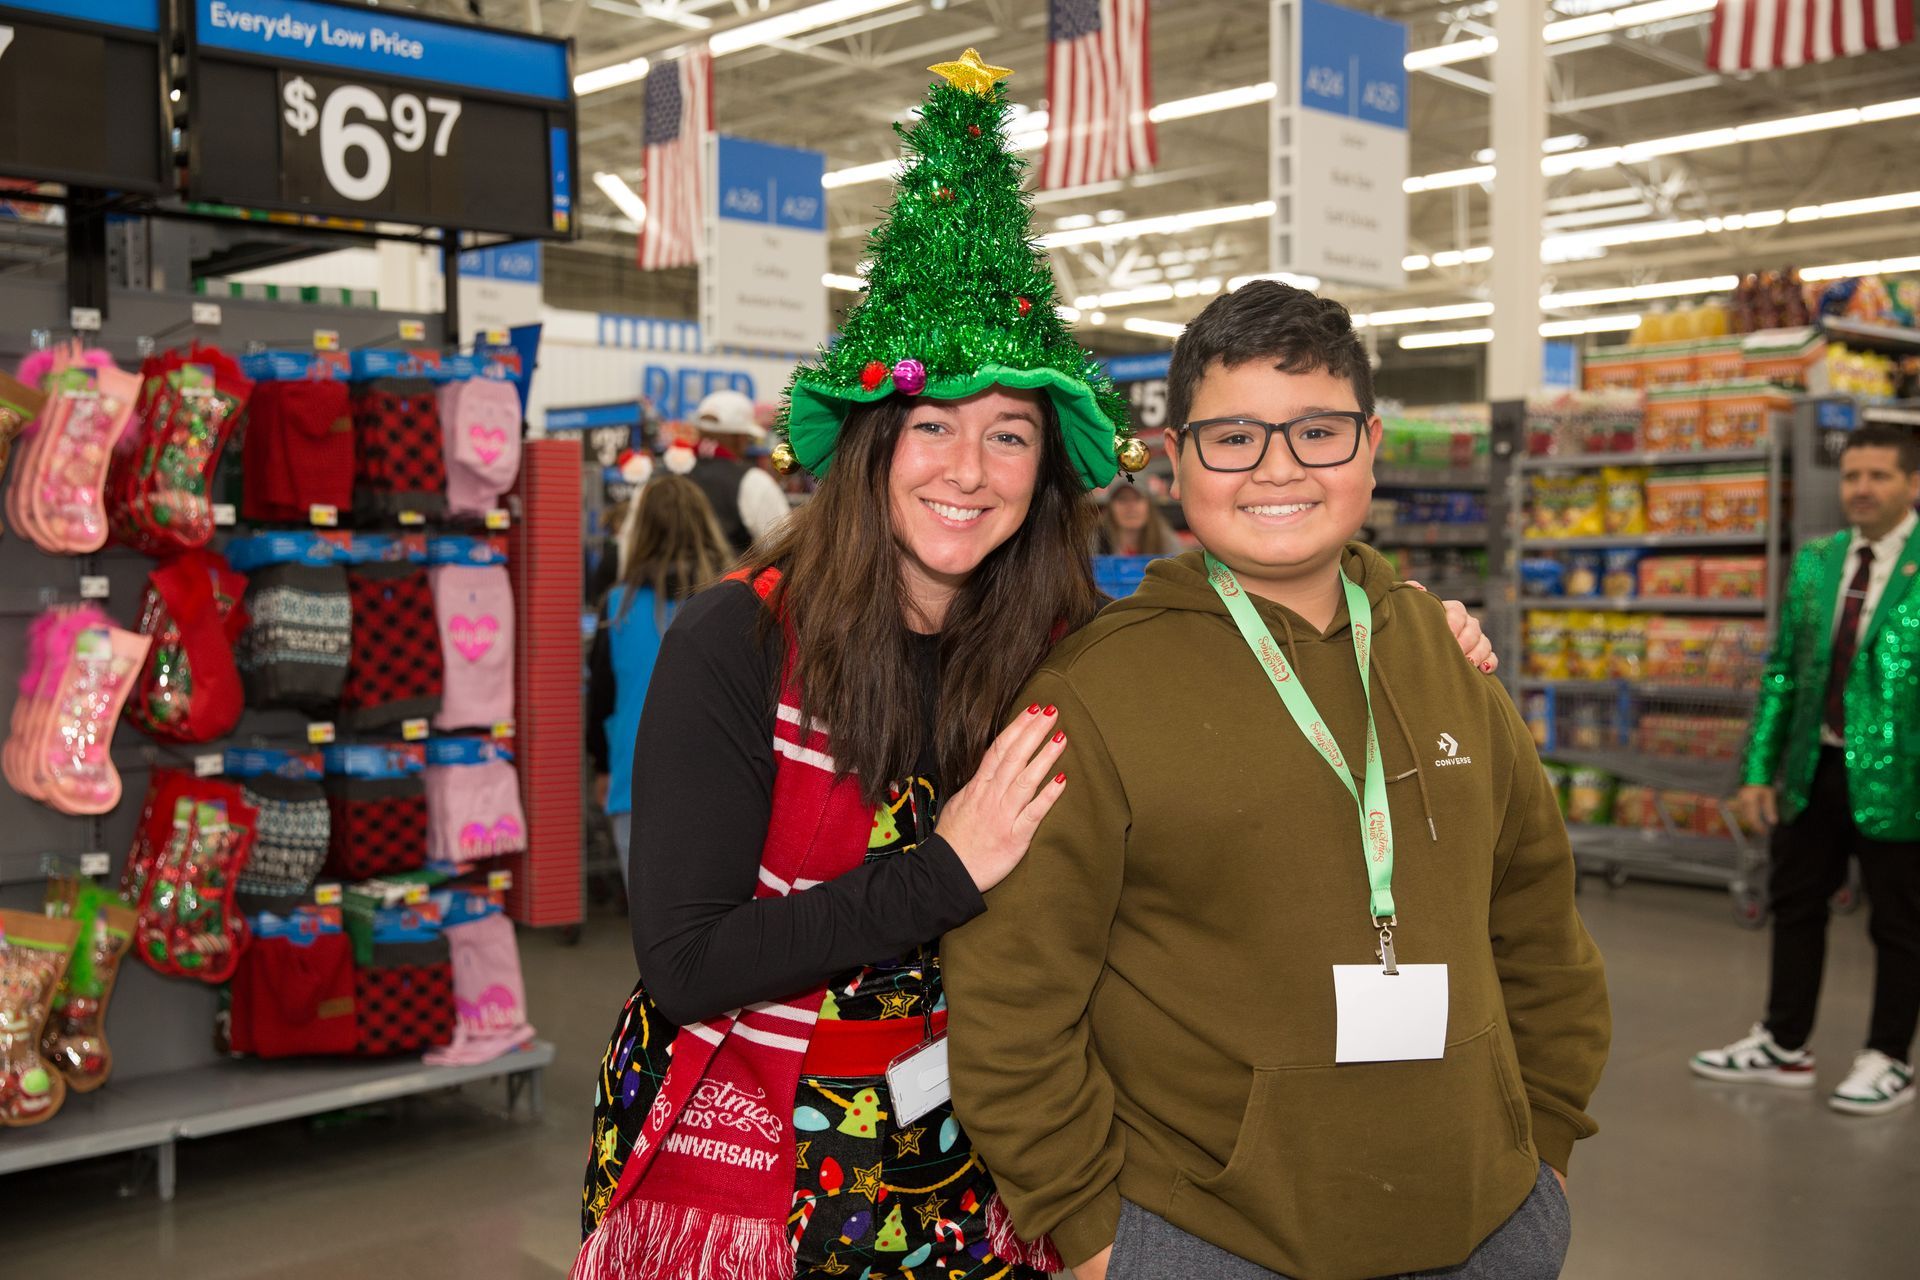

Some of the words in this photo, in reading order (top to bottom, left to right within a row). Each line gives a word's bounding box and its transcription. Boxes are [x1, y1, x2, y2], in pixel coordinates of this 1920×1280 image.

[210, 1, 317, 48] Everyday
[321, 20, 365, 49] Low
[370, 28, 424, 59] Price
[724, 186, 763, 215] A26
[780, 195, 818, 222] A27
[1435, 757, 1472, 767] CONVERSE
[677, 1109, 717, 1130] IDS
[661, 1132, 779, 1172] NNIVERSARY
